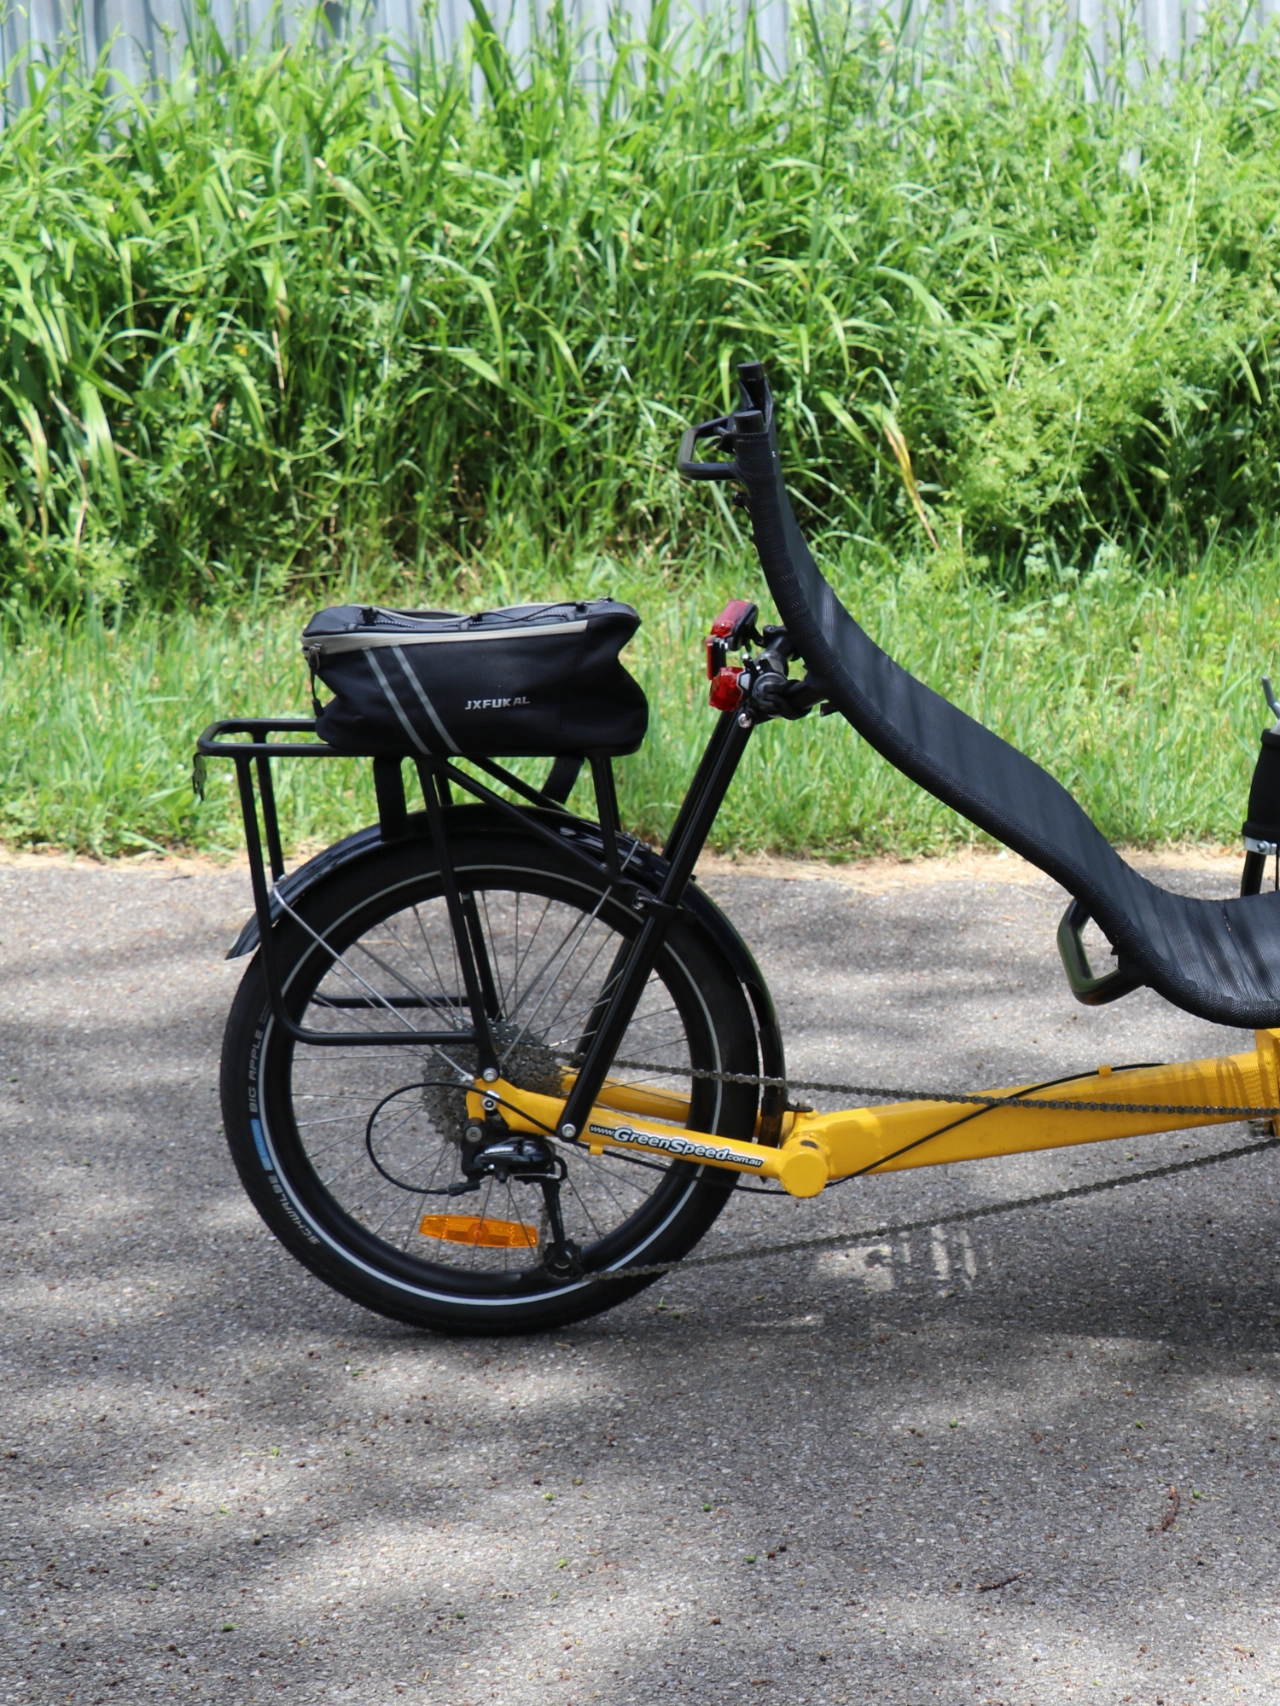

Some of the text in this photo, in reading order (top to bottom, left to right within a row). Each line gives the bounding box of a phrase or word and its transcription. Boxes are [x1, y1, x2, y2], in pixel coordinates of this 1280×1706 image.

[464, 696, 530, 710] JXFUKAL
[248, 1029, 262, 1114] BIG APPLE
[267, 1174, 321, 1246] SCHWALBE
